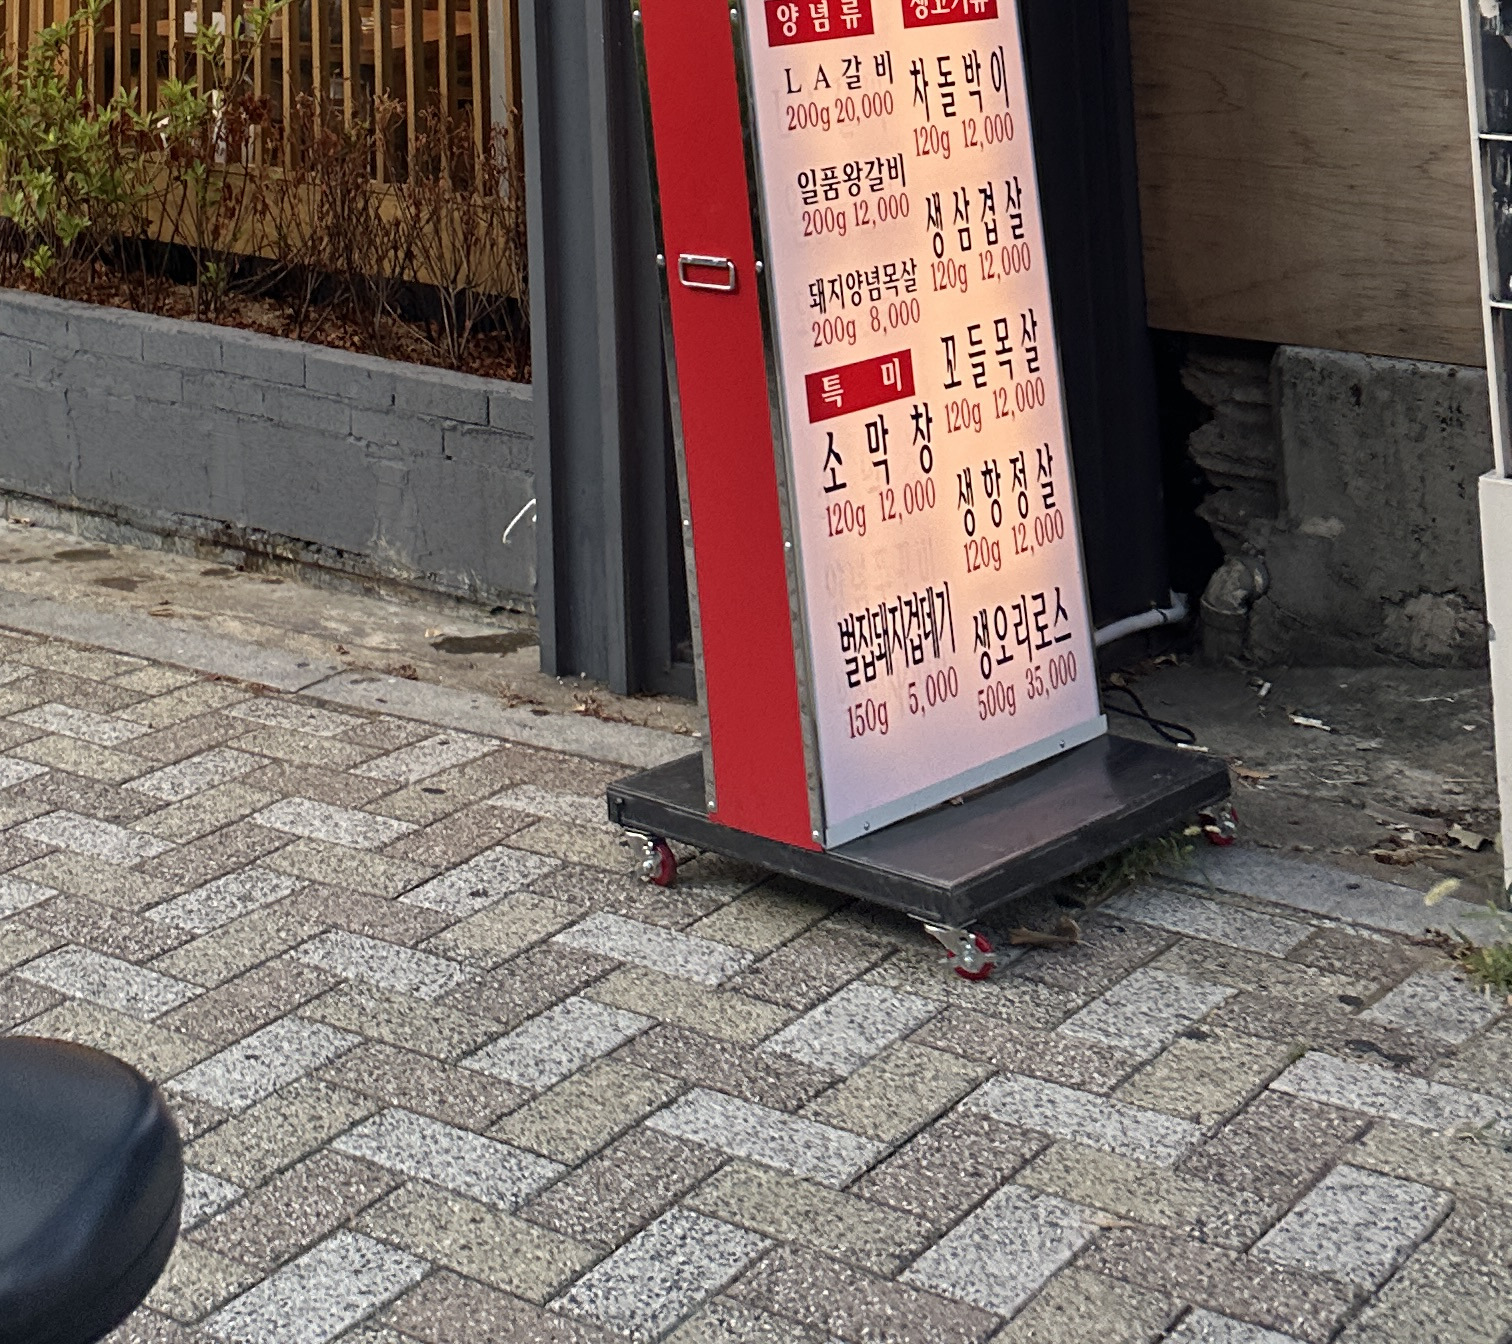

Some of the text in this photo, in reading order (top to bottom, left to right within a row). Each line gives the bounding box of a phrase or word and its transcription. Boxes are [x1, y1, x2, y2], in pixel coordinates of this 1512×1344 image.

[787, 90, 894, 132] 200g 20,000
[909, 45, 1010, 123] 차돌박이
[913, 112, 1014, 159] 120g 12,000
[797, 153, 906, 206] 일품왕갈비
[802, 193, 910, 237] 200g 12,000
[925, 176, 1025, 258] 생삼겹살
[808, 258, 918, 314] 돼지양념목살
[930, 242, 1031, 293] 120g 12,000
[812, 298, 920, 348] 200g 8,000
[944, 377, 1045, 433] 120g 12,000
[825, 477, 936, 537] 120g 12,000
[956, 442, 1056, 537] 생항정살
[963, 536, 1002, 574] 120g
[1011, 509, 1064, 557] 12,000
[973, 586, 1072, 680] 생오리로스
[847, 666, 959, 739] 150g 5,000
[977, 650, 1077, 721] 500g 35,000
